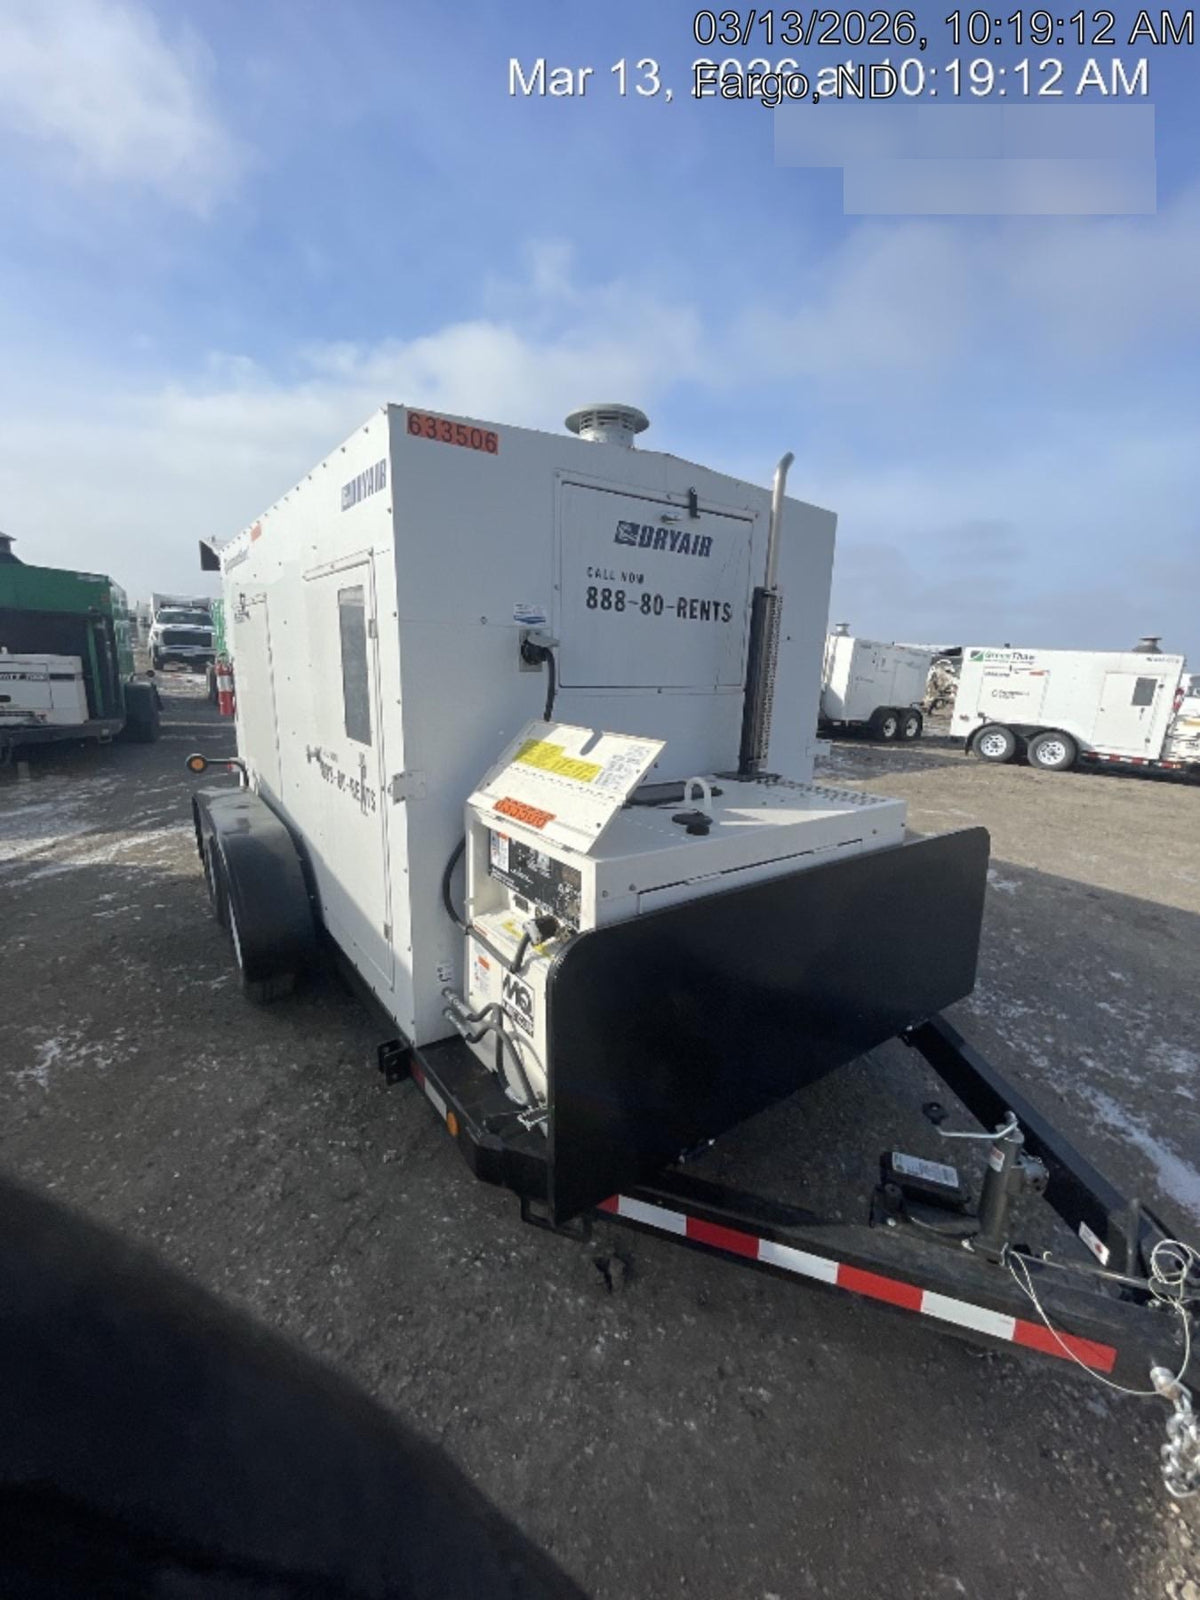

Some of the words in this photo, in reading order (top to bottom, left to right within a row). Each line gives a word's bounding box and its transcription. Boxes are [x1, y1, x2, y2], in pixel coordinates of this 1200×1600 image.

[408, 411, 498, 454] 633506
[638, 525, 713, 557] DRYAIR
[586, 566, 615, 581] CALL
[621, 571, 645, 584] NOW
[585, 585, 733, 623] 888-80-RENTS
